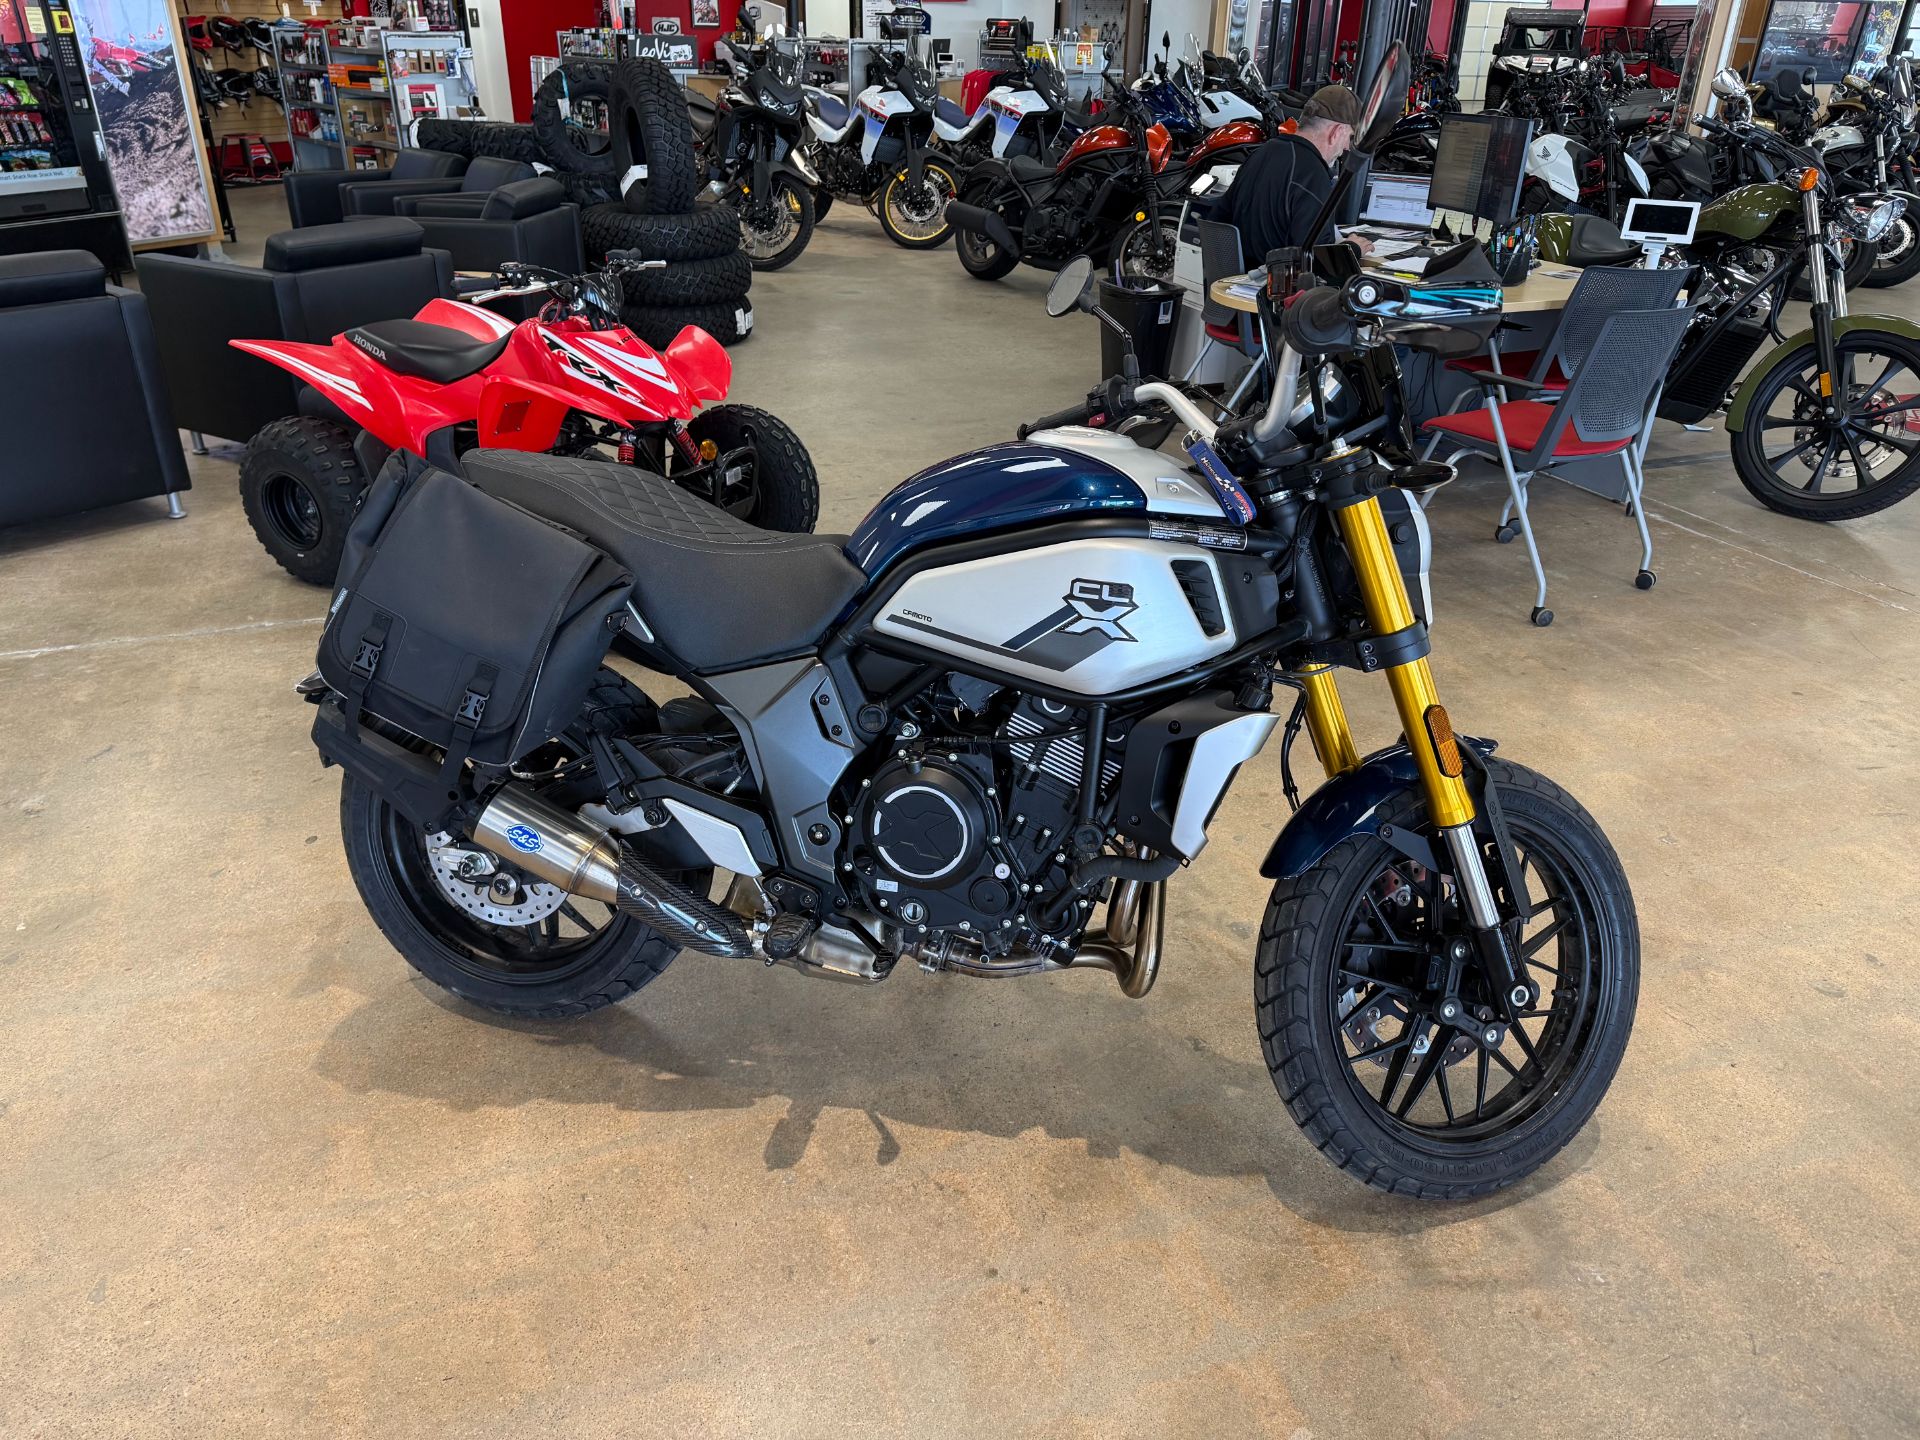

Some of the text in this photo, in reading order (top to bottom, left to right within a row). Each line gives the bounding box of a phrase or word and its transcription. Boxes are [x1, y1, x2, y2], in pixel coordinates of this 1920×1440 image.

[657, 23, 675, 32] HJC
[636, 38, 693, 60] LeoVi
[353, 333, 387, 360] HONDA
[902, 609, 932, 623] CFMOTO
[510, 829, 539, 848] S&S
